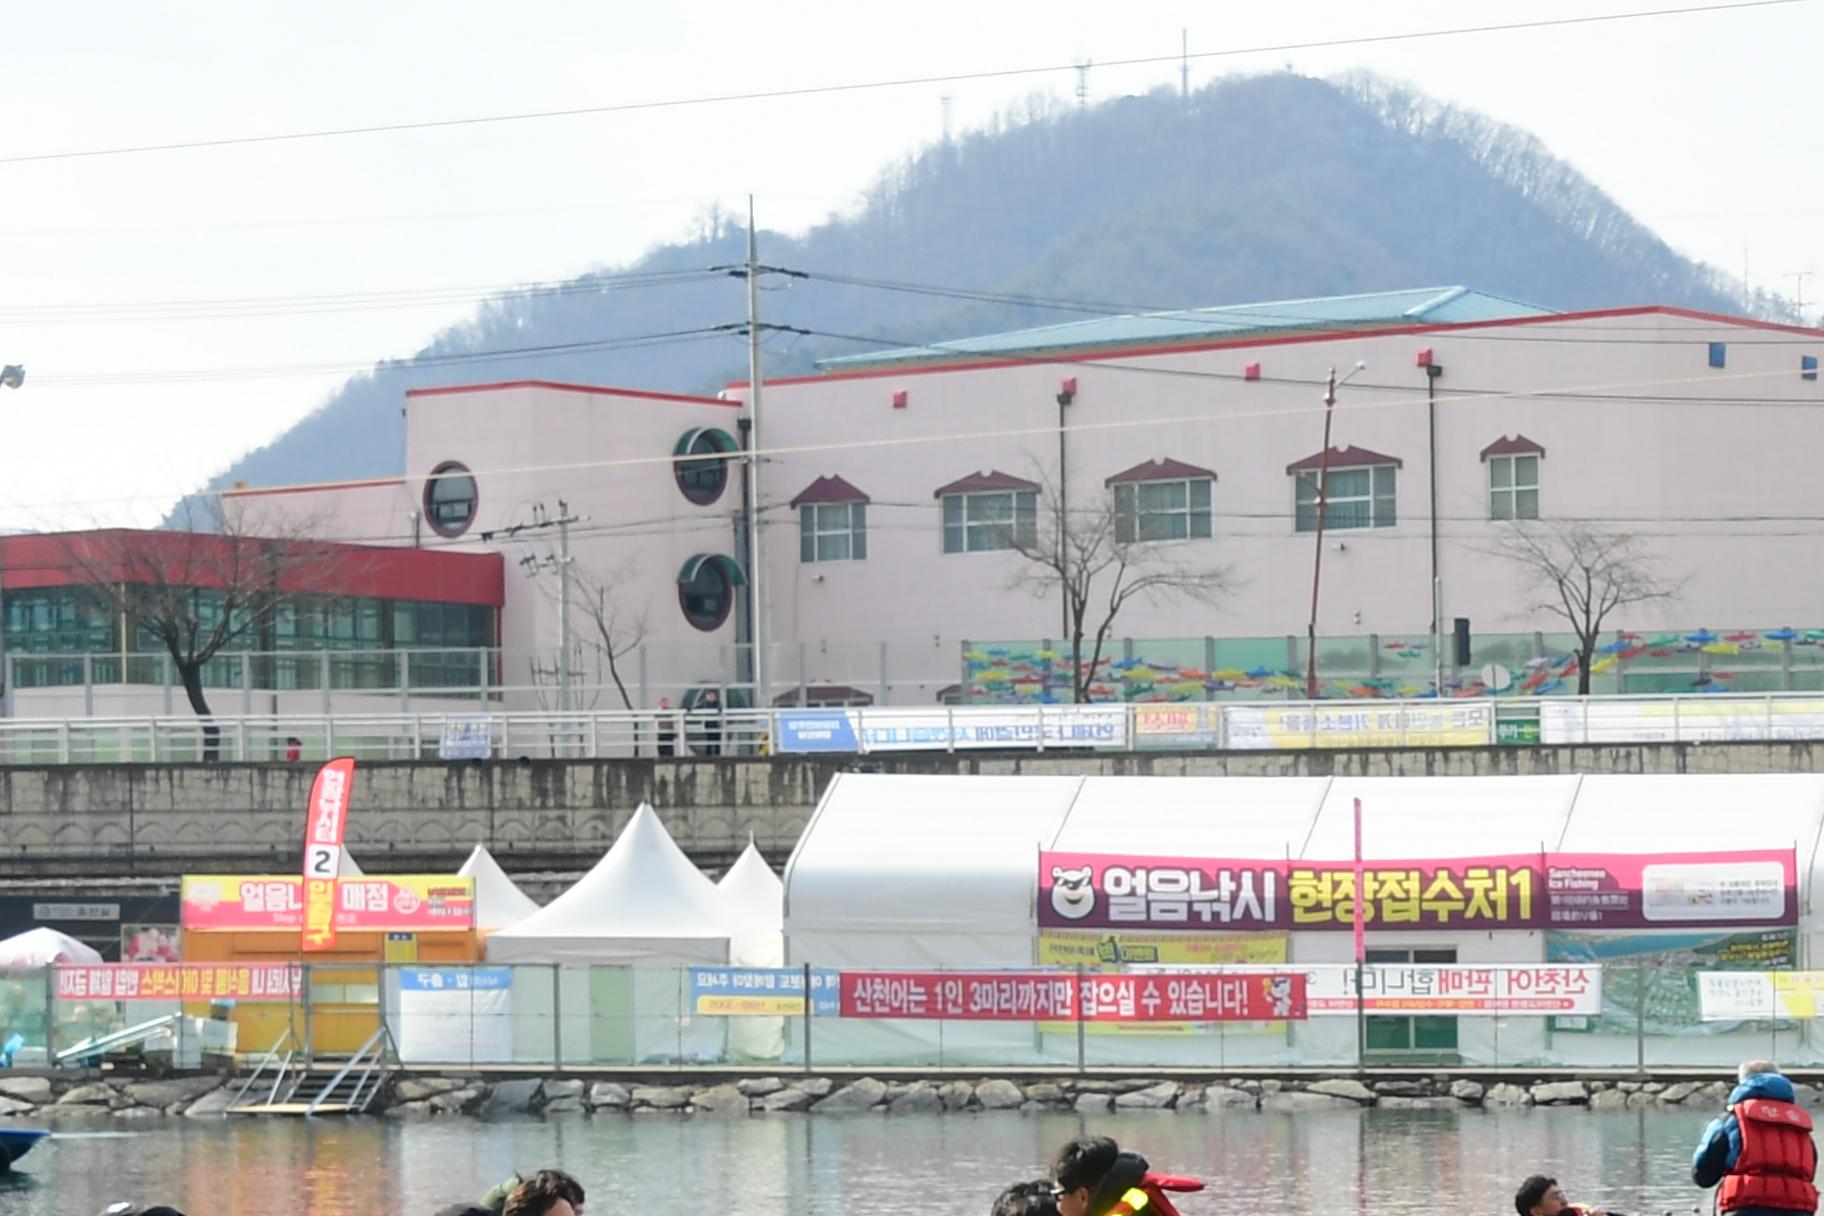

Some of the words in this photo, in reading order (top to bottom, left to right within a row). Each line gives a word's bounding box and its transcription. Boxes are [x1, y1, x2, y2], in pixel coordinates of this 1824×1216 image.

[314, 851, 331, 873] 2
[342, 882, 388, 912] 매점
[1103, 866, 1275, 923] 얼음낚시
[1288, 866, 1531, 924] 현장접수처1
[853, 979, 928, 1014] 산천어는
[935, 980, 963, 1014] 1인
[969, 980, 1073, 1015] 3마리까지만
[1079, 980, 1136, 1016] 잡으실
[1141, 982, 1162, 1015] 수
[1168, 981, 1249, 1016] 있습니다!
